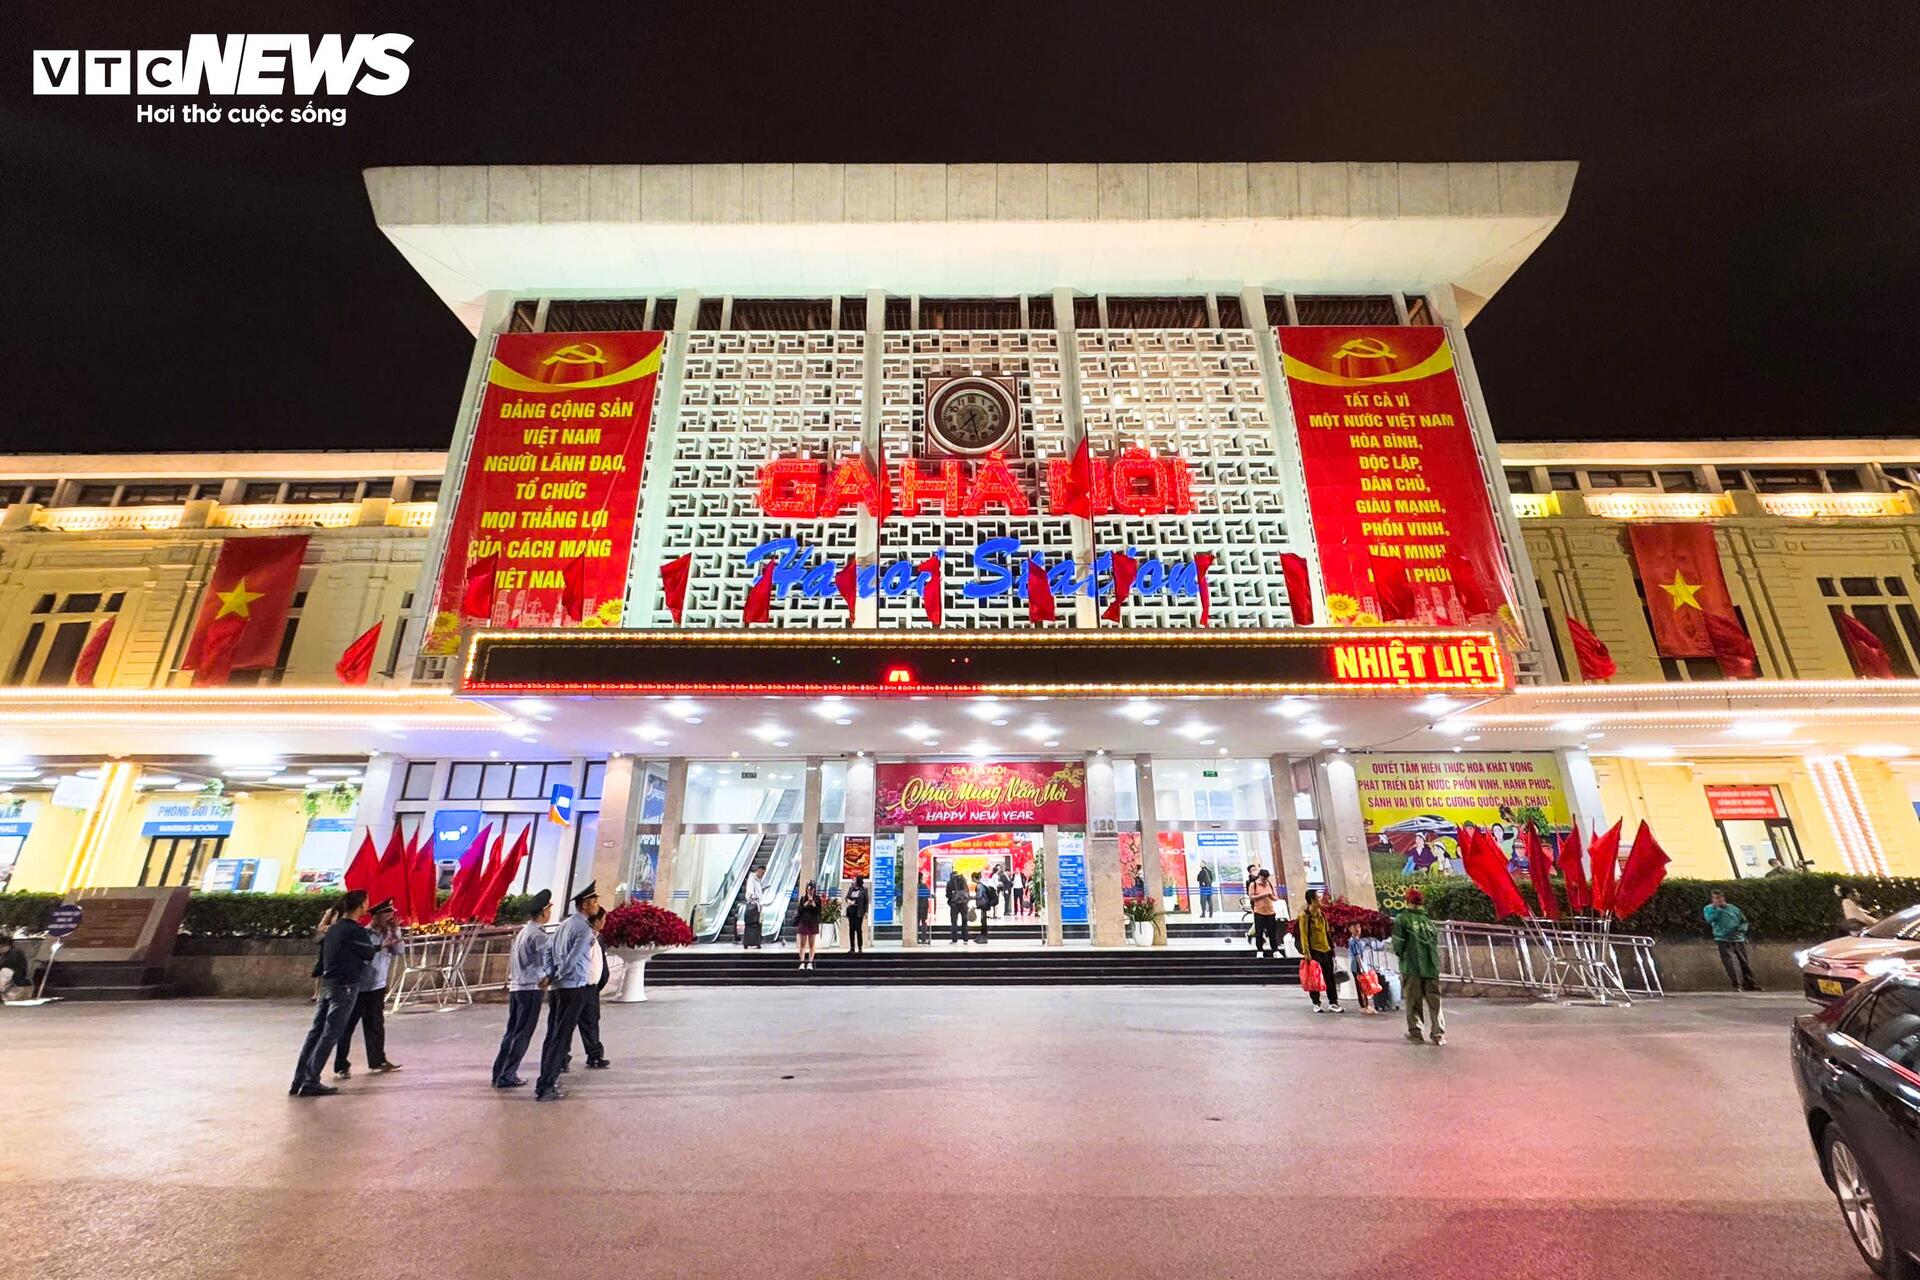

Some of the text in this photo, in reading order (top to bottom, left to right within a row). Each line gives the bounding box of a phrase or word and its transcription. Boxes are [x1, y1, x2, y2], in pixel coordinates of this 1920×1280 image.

[500, 397, 634, 421] ĐẢNG CỘNG SẢN
[1344, 391, 1410, 407] TẤT CẢ VÌ
[1308, 413, 1455, 430] MỘT NƯỚC VIỆT NAM
[523, 426, 602, 448] VIỆT NAM
[1350, 432, 1423, 450] HÒA BÌNH,
[484, 452, 626, 475] NGƯỜI LÃNH ĐẠO,
[1359, 454, 1423, 472] ĐỘC LẬP,
[515, 477, 588, 500] TỔ CHỨC
[758, 458, 881, 518] GA
[899, 451, 1029, 518] HÀ
[1360, 474, 1431, 493] DÂN CHỦ,
[1355, 497, 1447, 516] GIÀU MẠNH,
[480, 505, 609, 532] MỌI THẮNG LỢI
[1407, 521, 1450, 537] VINH,
[467, 535, 502, 559] CỦA
[507, 537, 555, 559] CÁCH
[1334, 639, 1498, 685] NHIỆT LIỆT
[926, 810, 1035, 822] HAPPY NEW YEAR
